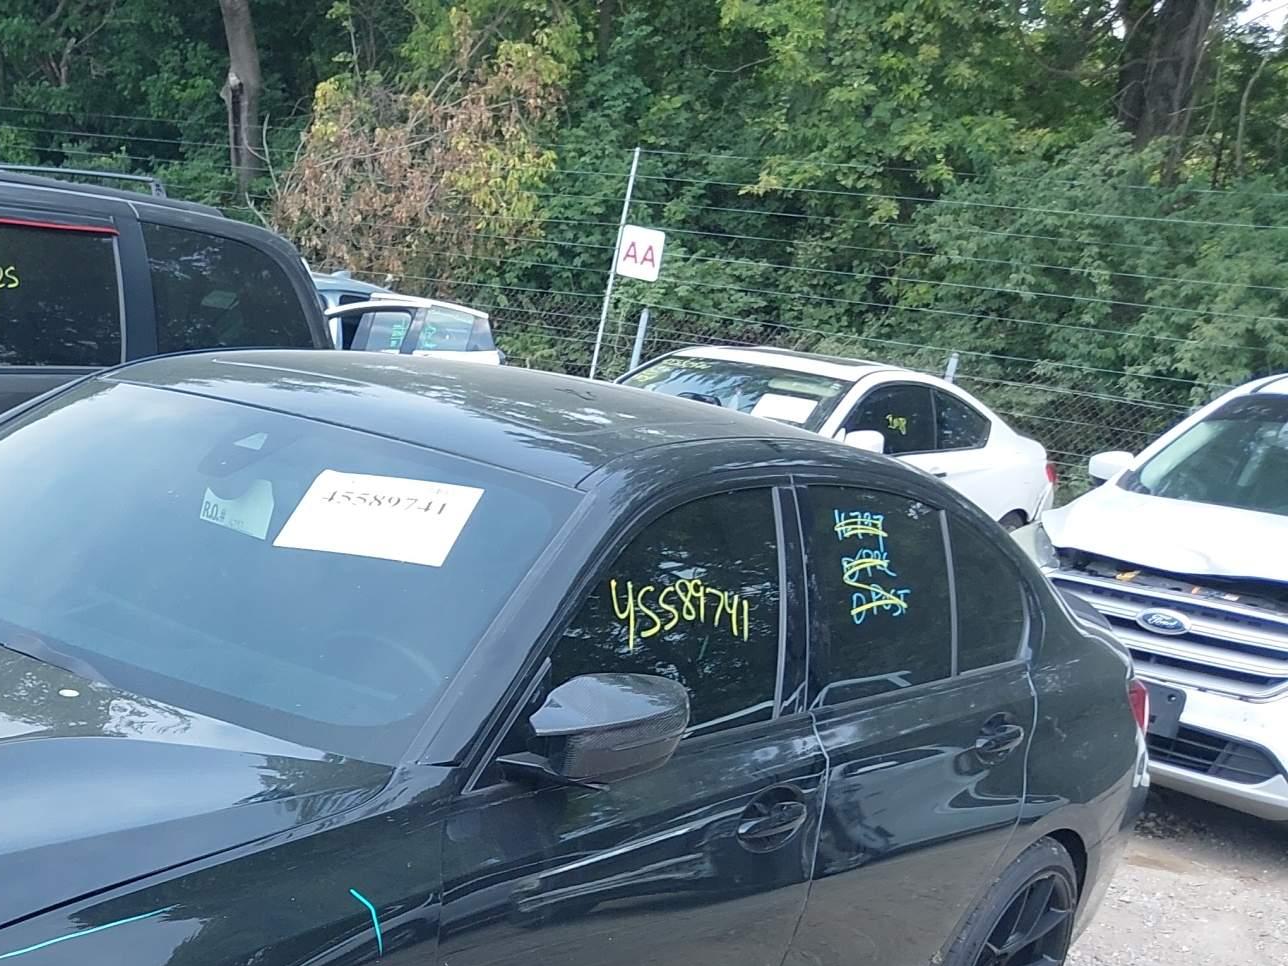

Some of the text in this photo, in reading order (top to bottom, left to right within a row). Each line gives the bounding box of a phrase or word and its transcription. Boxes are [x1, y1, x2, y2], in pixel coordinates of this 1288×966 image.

[623, 242, 656, 268] AA
[321, 490, 448, 515] 45589741
[1147, 614, 1178, 628] Ford
